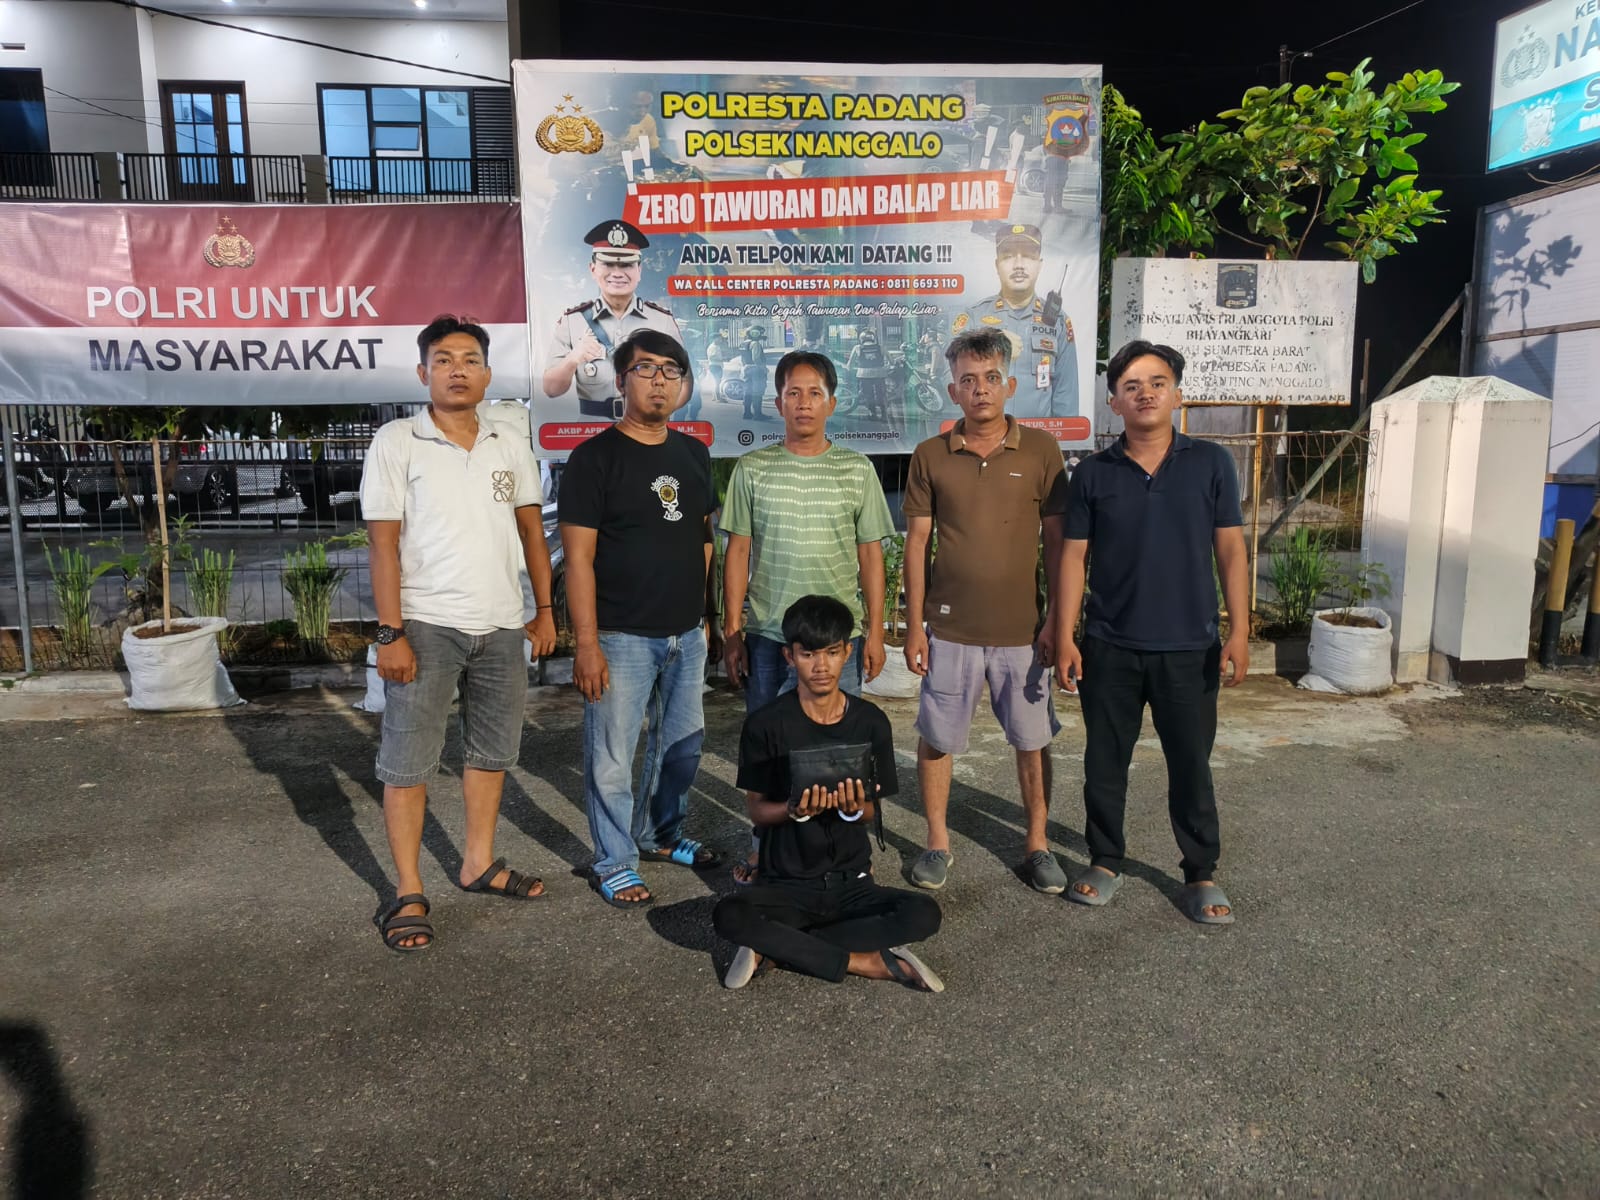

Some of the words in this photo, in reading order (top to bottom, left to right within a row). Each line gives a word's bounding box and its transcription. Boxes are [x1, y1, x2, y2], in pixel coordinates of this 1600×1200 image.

[1576, 0, 1600, 19] KE
[662, 92, 829, 119] POLRESTA
[834, 93, 965, 120] PADANG
[686, 131, 791, 156] POLSEK
[793, 130, 943, 157] NANGGALO
[637, 193, 696, 226] ZERO
[700, 188, 815, 223] TAWURAN
[821, 185, 868, 217] DAN
[873, 182, 946, 215] BALAP
[950, 180, 1000, 211] LIAR
[680, 244, 733, 264] ANDA
[736, 244, 807, 264] TELPON
[809, 244, 854, 264] KAMI
[862, 244, 933, 264] DATANG
[674, 279, 693, 290] WA
[695, 279, 724, 290] CALL
[727, 279, 771, 290] CENTER
[773, 279, 831, 290] POLRESTA
[833, 279, 879, 290] PADANG
[886, 278, 910, 289] 0811
[912, 278, 939, 289] 6693
[941, 278, 958, 289] 110
[86, 285, 217, 320] POLRI
[231, 285, 379, 320] UNTUK
[697, 303, 742, 317] Bersama
[743, 303, 769, 317] Kita
[771, 303, 804, 322] Cegah
[806, 303, 851, 316] Tawuran
[854, 303, 876, 316] Dan
[878, 302, 909, 320] Balap
[1239, 314, 1297, 326] ANGGOTA
[1032, 326, 1057, 337] POLRI
[1186, 330, 1272, 341] BHAYANGKARI
[88, 337, 384, 373] MASYARAKAT
[1204, 345, 1269, 357] SUMATERA
[1273, 346, 1311, 357] BARAT
[557, 427, 583, 435] AKBP
